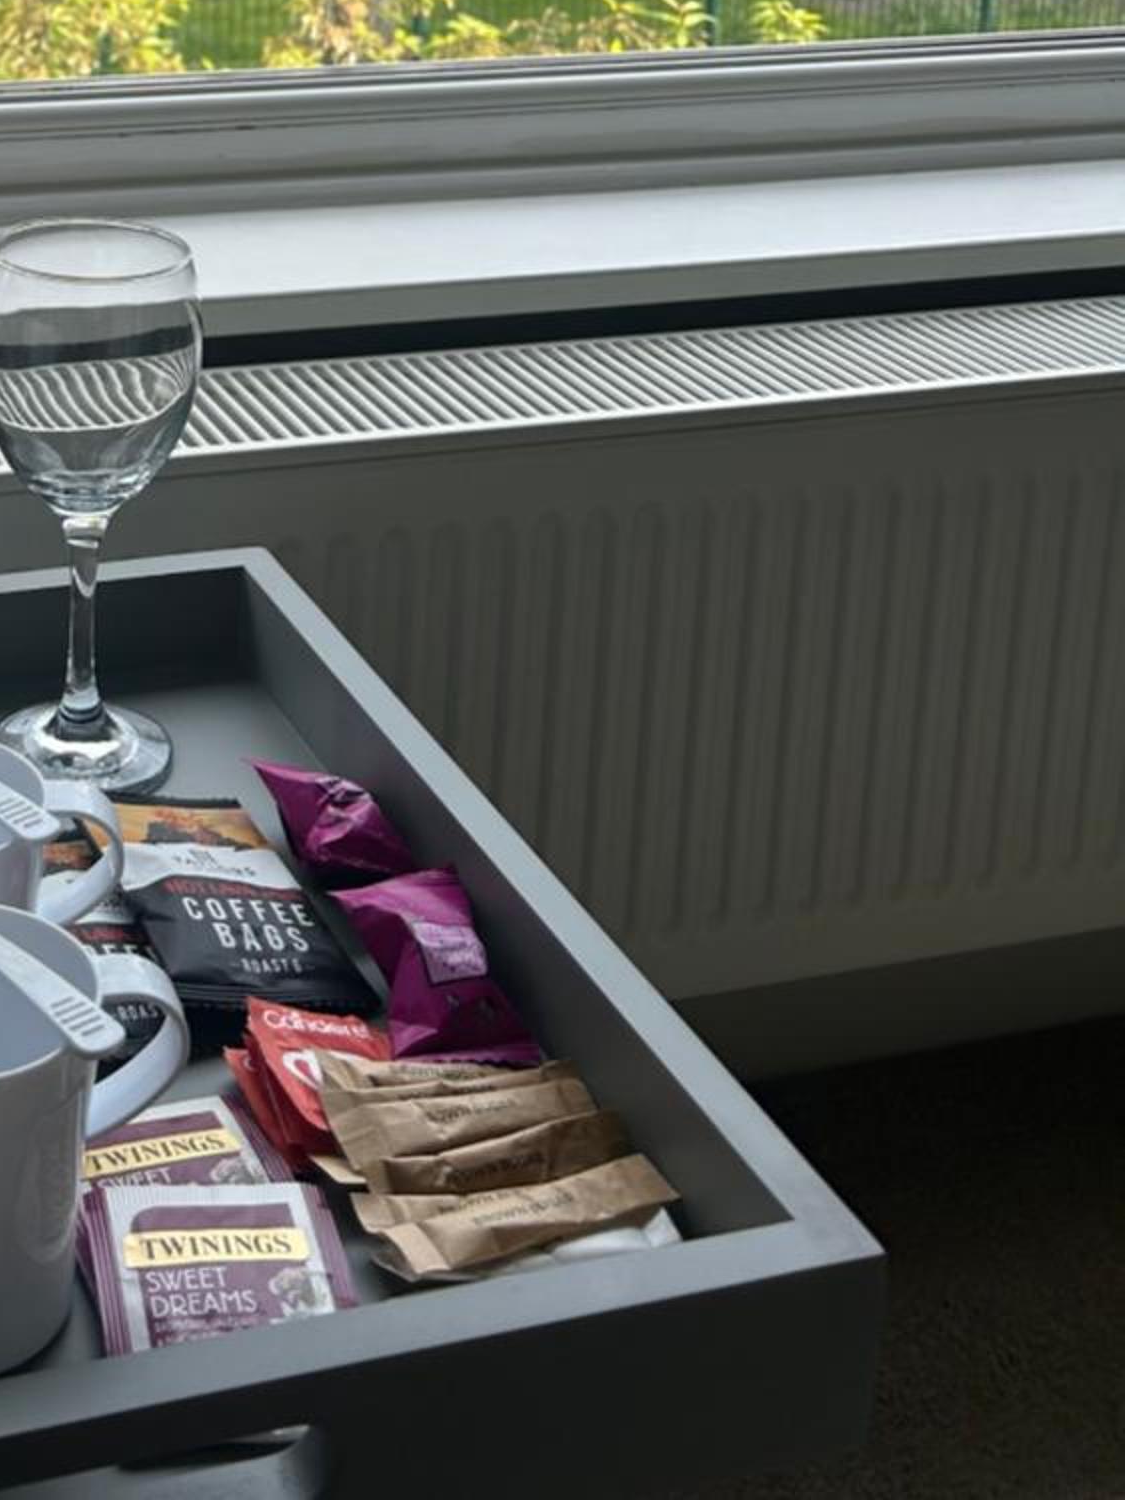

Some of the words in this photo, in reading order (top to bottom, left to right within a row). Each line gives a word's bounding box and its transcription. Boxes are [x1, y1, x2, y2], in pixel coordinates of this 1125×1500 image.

[181, 897, 315, 927] COFFEE
[212, 922, 309, 952] BAGS
[117, 1002, 159, 1021] ROAS
[84, 1134, 225, 1173] TWININGS
[139, 1233, 293, 1261] TWININGS
[145, 1266, 227, 1293] SWEET
[148, 1289, 258, 1318] DREAMS
